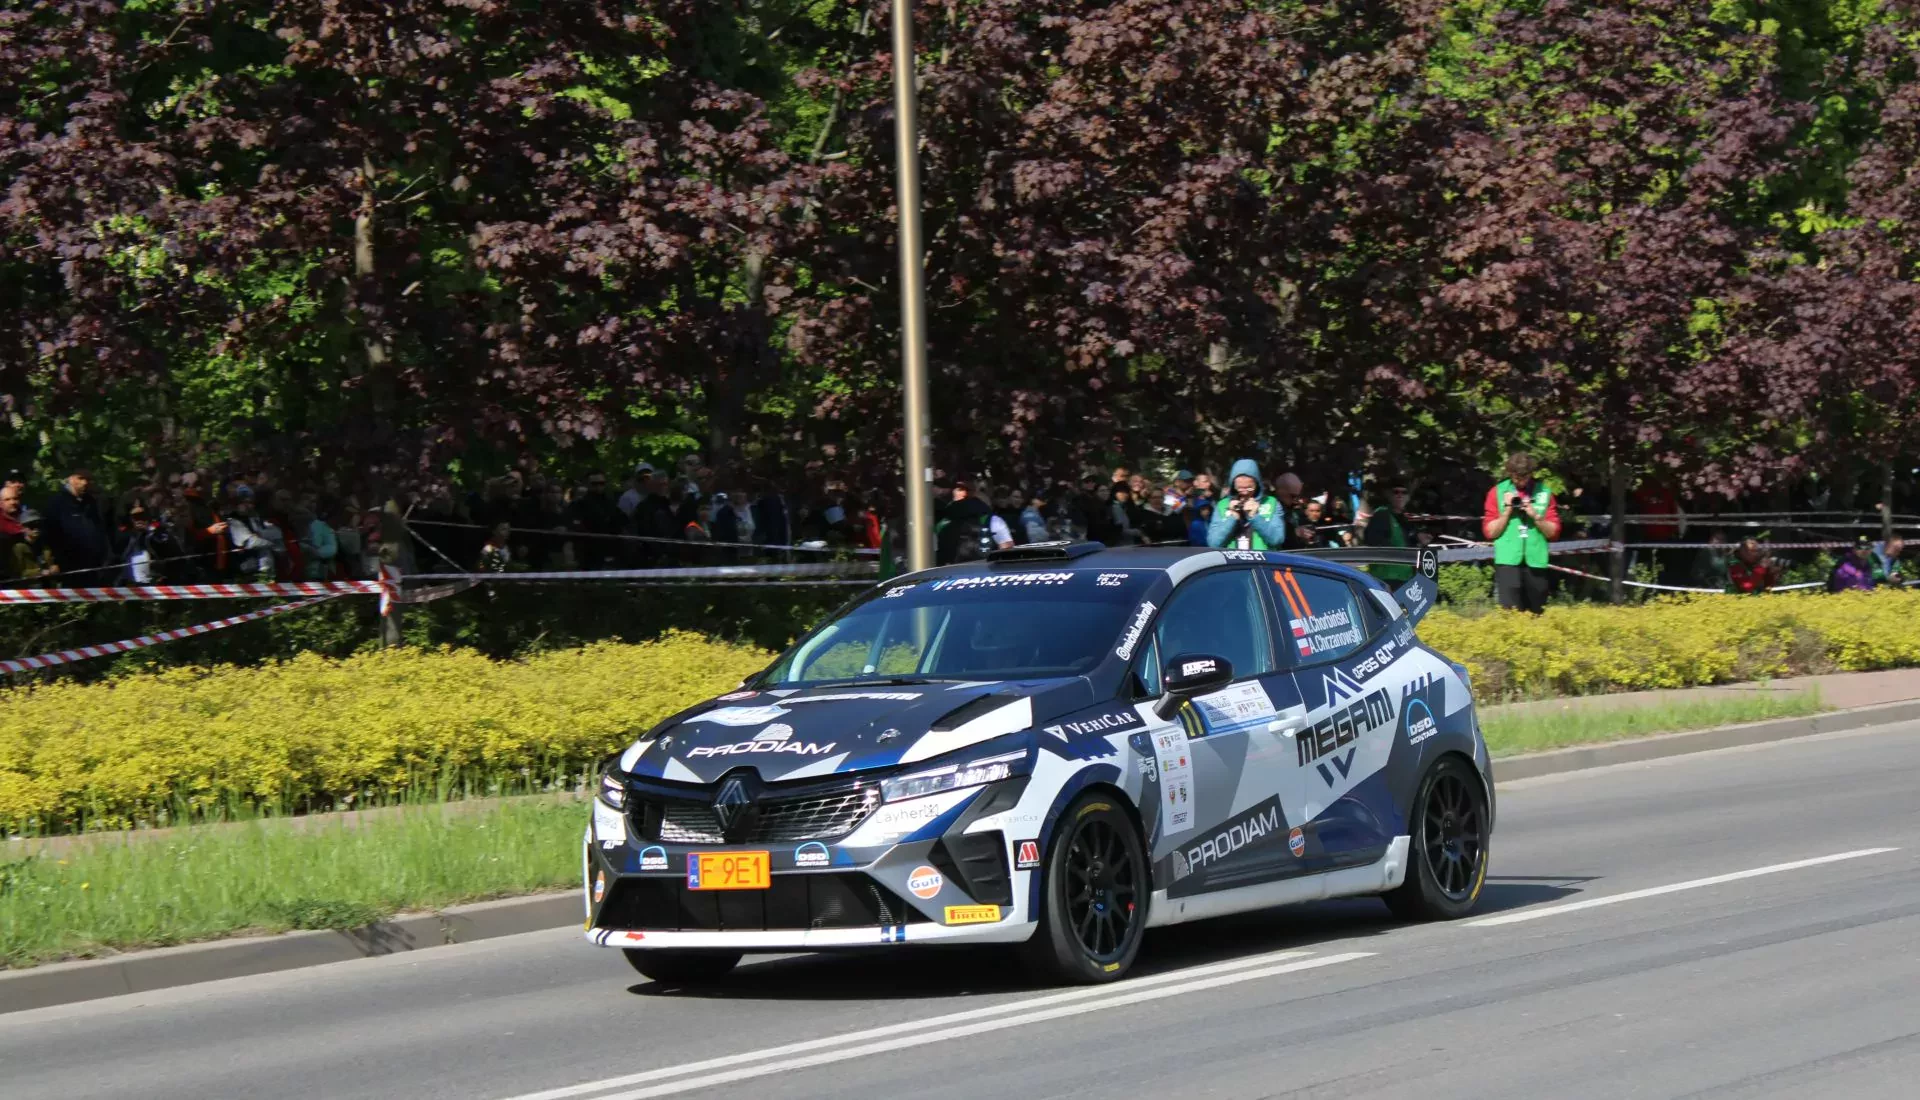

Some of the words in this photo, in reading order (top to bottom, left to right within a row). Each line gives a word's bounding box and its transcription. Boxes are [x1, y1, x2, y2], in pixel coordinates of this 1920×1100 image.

[951, 572, 1074, 586] PANTHEON
[1273, 567, 1313, 619] 11
[1295, 687, 1396, 768] MEGAMI
[686, 740, 837, 759] PRODIAM
[1187, 806, 1279, 873] PRODIAM
[1290, 836, 1304, 849] Gulf
[701, 858, 714, 885] F
[722, 856, 761, 885] 9E1
[910, 876, 942, 889] Gulf
[950, 908, 996, 920] PIRELLI
